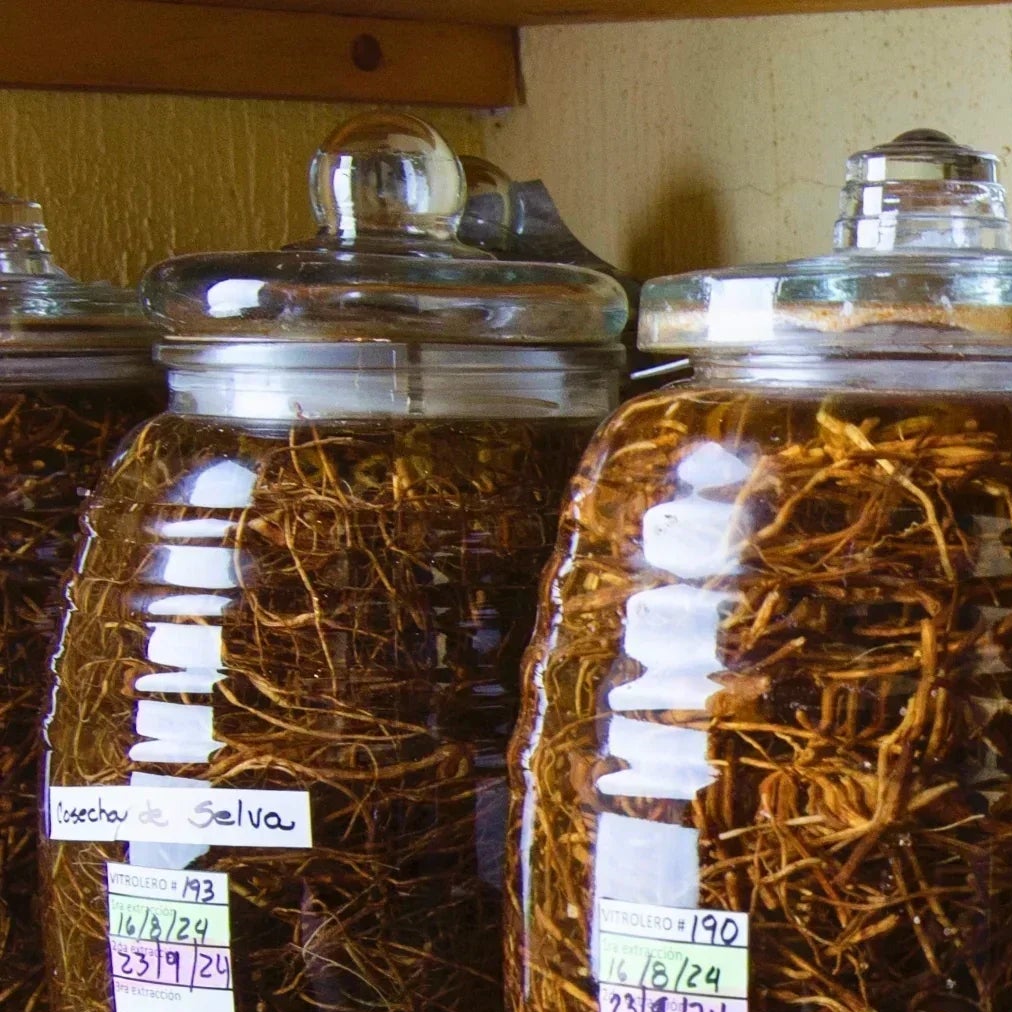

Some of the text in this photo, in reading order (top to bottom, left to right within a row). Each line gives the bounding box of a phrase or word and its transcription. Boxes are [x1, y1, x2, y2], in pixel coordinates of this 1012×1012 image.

[57, 797, 296, 831] Cosecha de Selva
[109, 872, 168, 891] VITROLERO
[182, 876, 215, 903] 193
[601, 908, 673, 931] VITROLERO
[691, 914, 739, 946] 190
